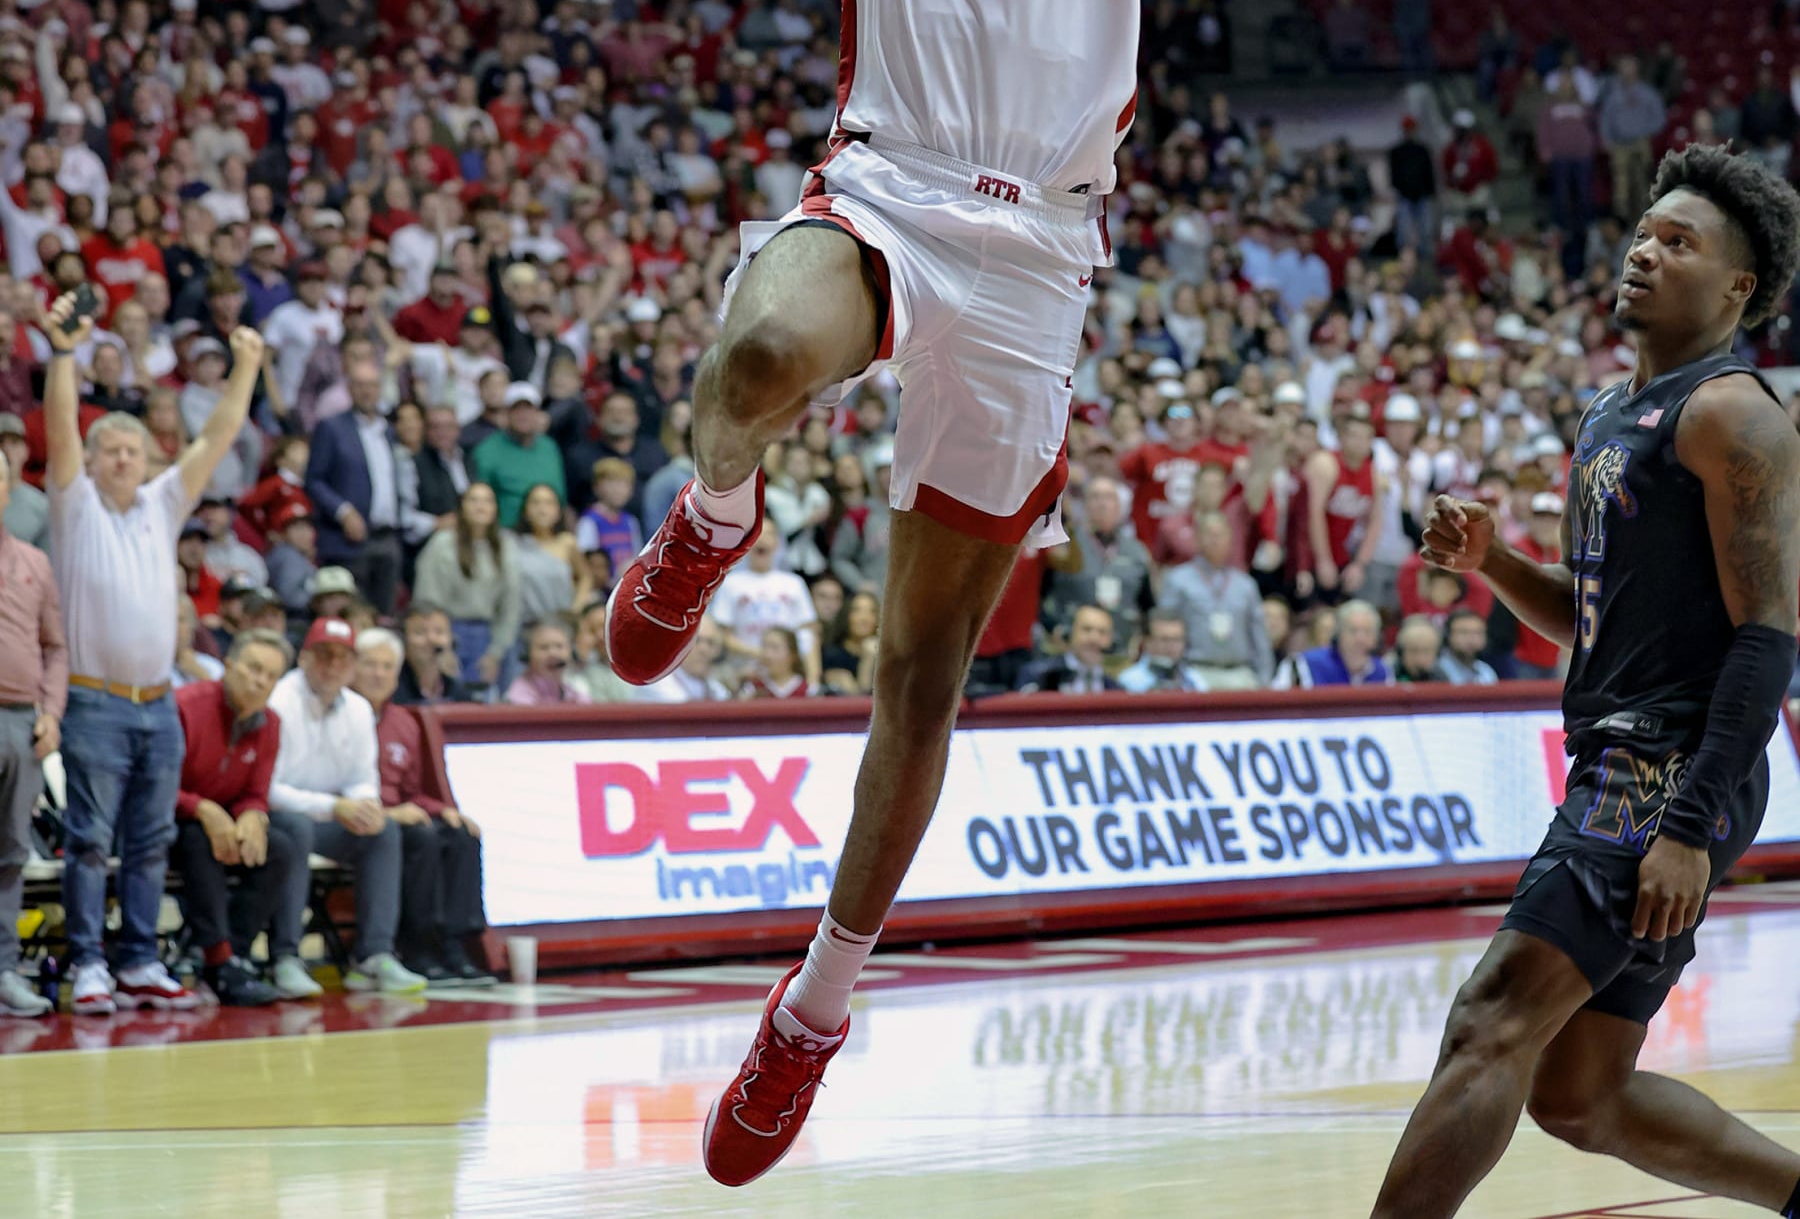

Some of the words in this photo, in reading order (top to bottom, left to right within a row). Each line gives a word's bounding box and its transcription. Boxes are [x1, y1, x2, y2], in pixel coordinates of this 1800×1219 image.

[975, 174, 1021, 204] RTR
[575, 757, 822, 859] DEX
[1020, 745, 1212, 807] THANK
[1211, 738, 1319, 797] YOU
[1322, 735, 1391, 792] TO
[967, 815, 1091, 880] OUR
[1095, 807, 1247, 872] GAME
[1250, 794, 1482, 862] SPONSOR
